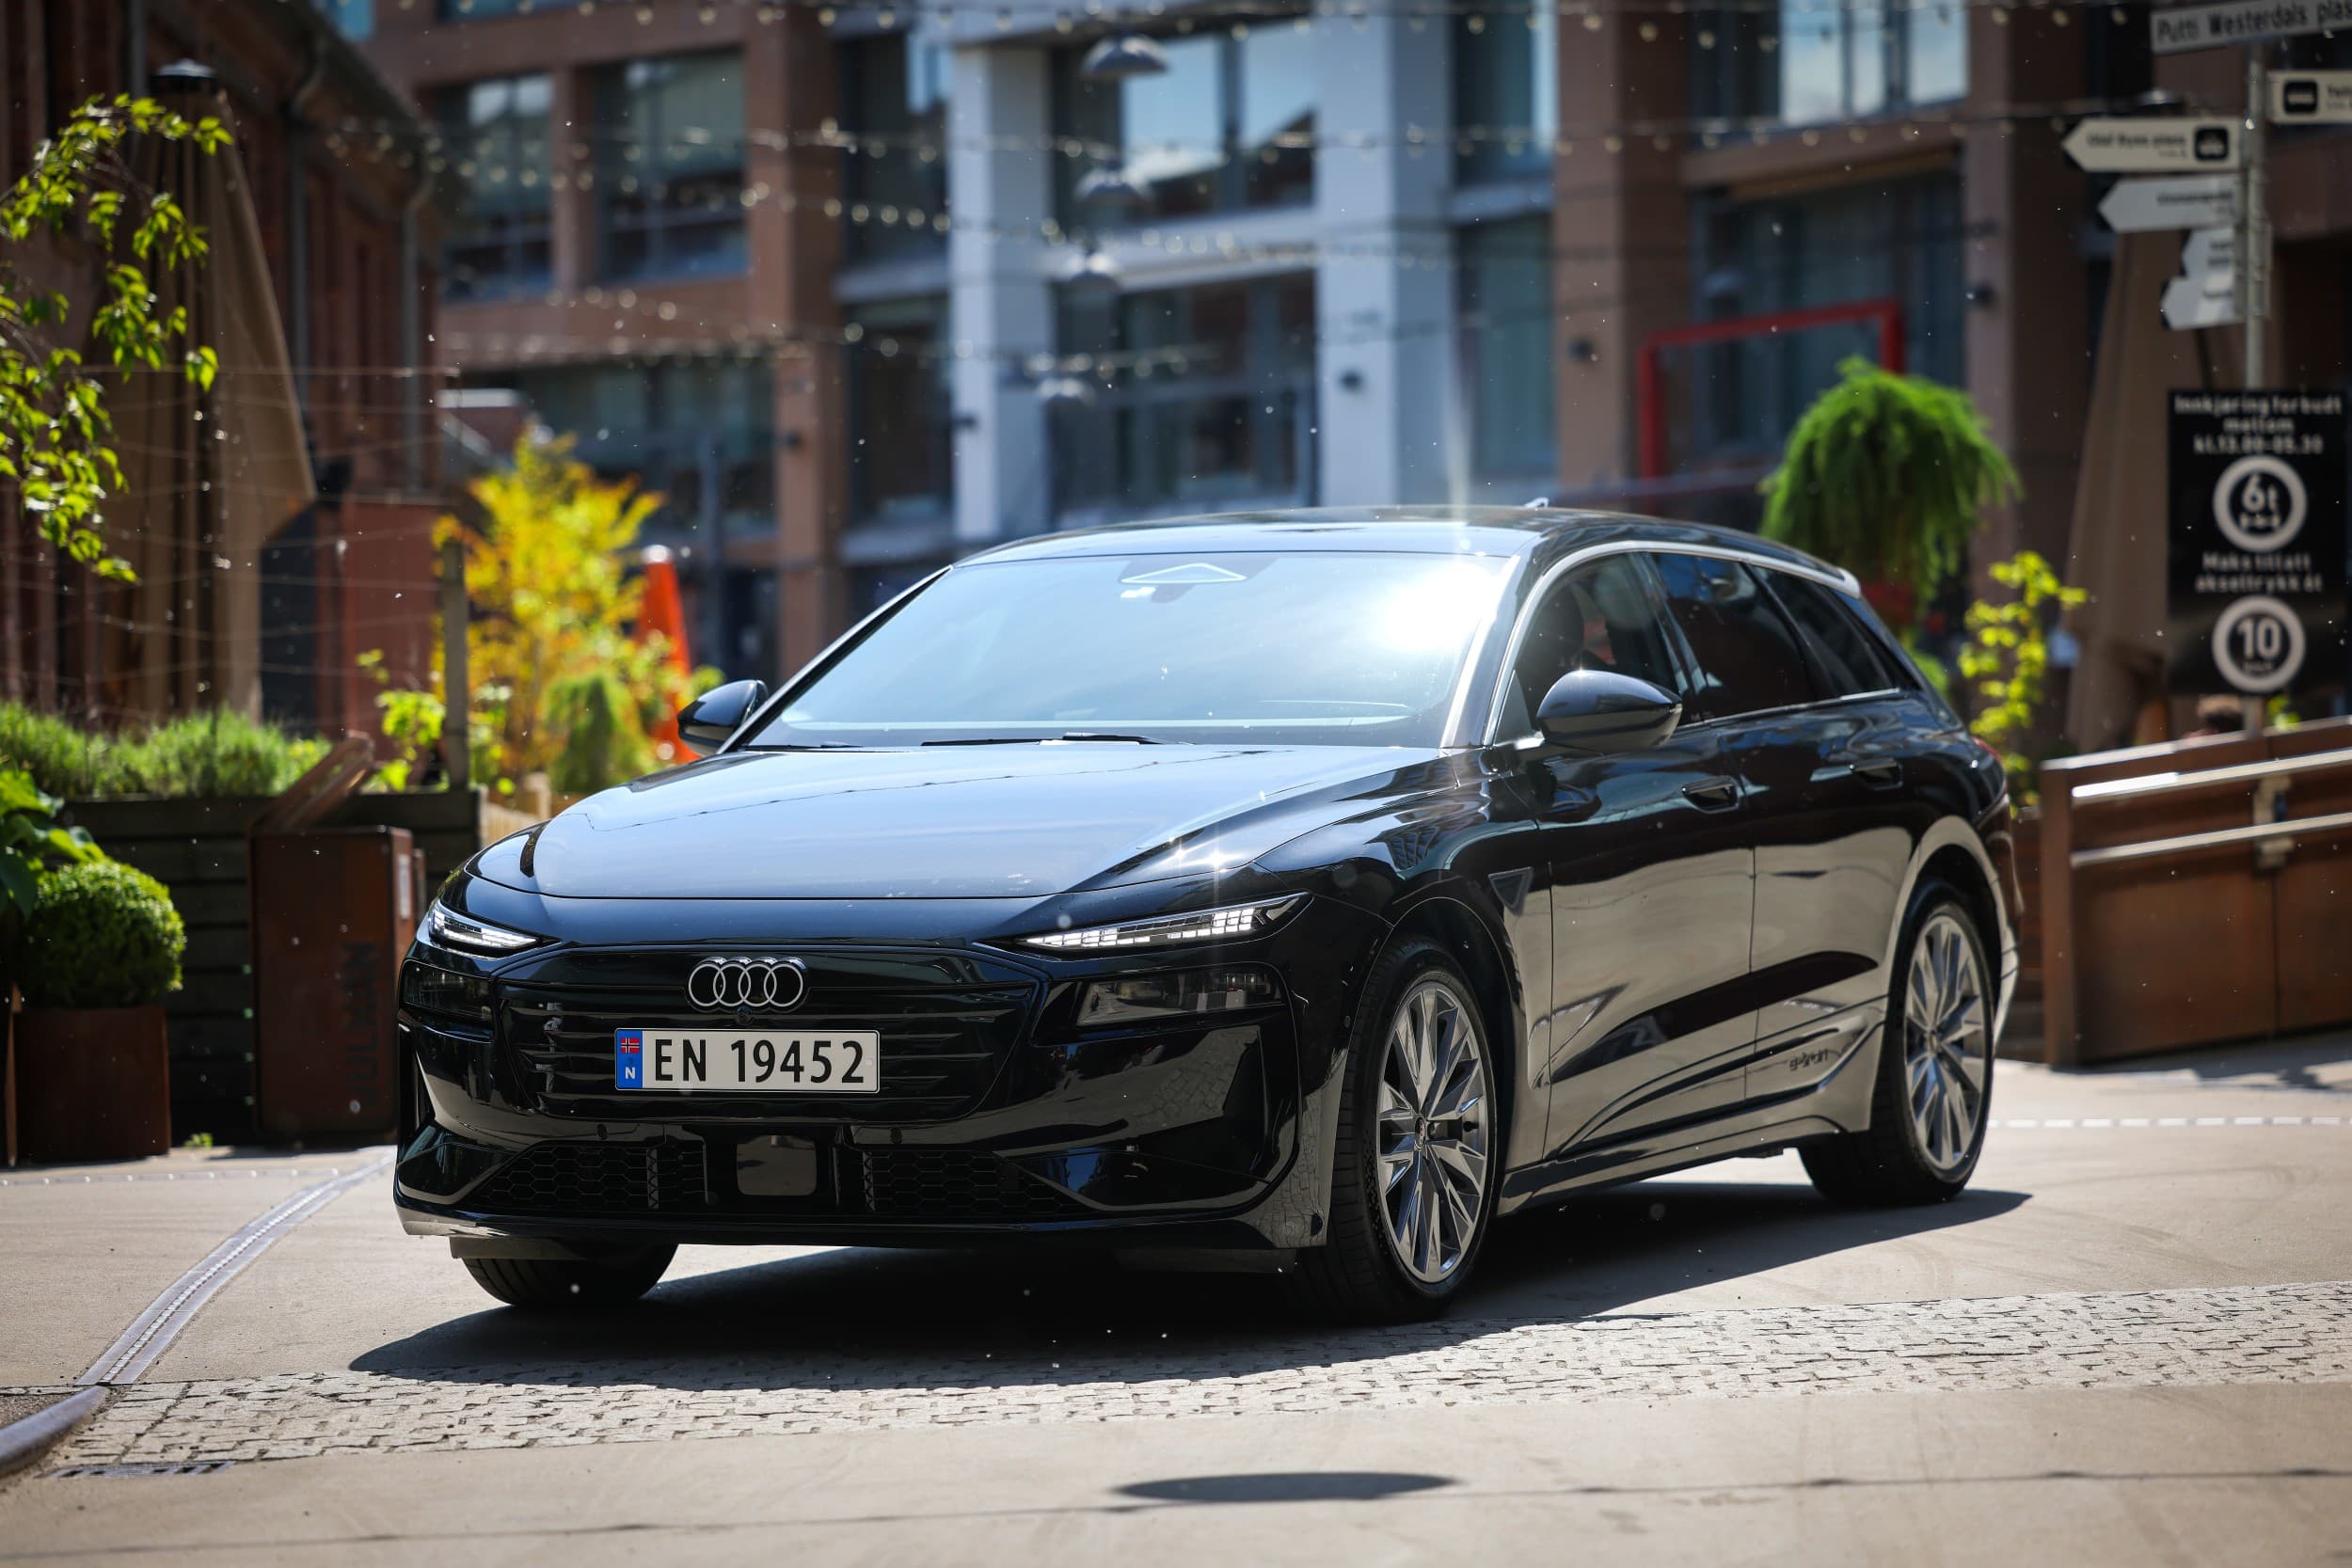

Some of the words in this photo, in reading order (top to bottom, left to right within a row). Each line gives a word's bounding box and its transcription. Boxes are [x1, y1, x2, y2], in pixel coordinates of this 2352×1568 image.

[2241, 472, 2280, 514] 6t
[2201, 551, 2251, 571] Maks
[2235, 616, 2282, 659] 10
[625, 1067, 636, 1080] N
[655, 1038, 707, 1083] EN
[730, 1038, 865, 1084] 19452
